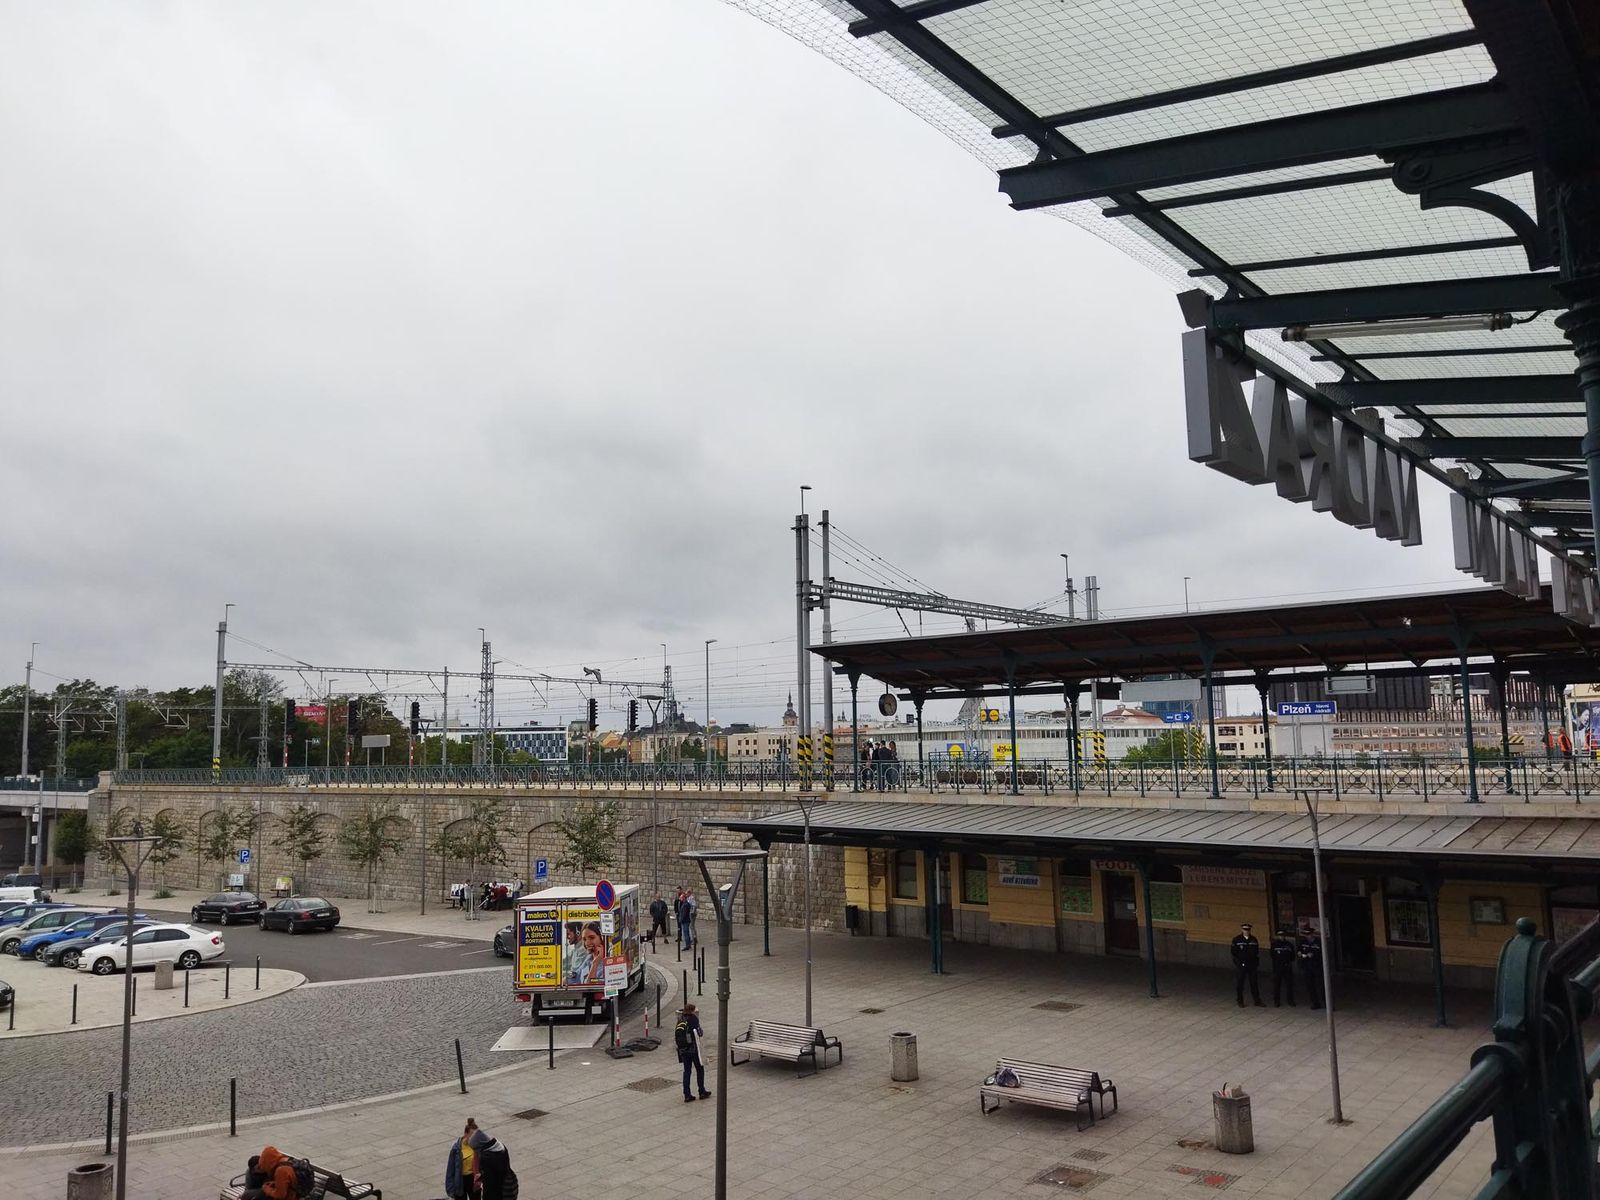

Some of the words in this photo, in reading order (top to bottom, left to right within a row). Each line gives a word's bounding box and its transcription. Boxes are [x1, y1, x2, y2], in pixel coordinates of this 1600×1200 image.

[1282, 704, 1311, 714] Plzeň
[242, 850, 249, 859] P
[538, 861, 545, 873] P
